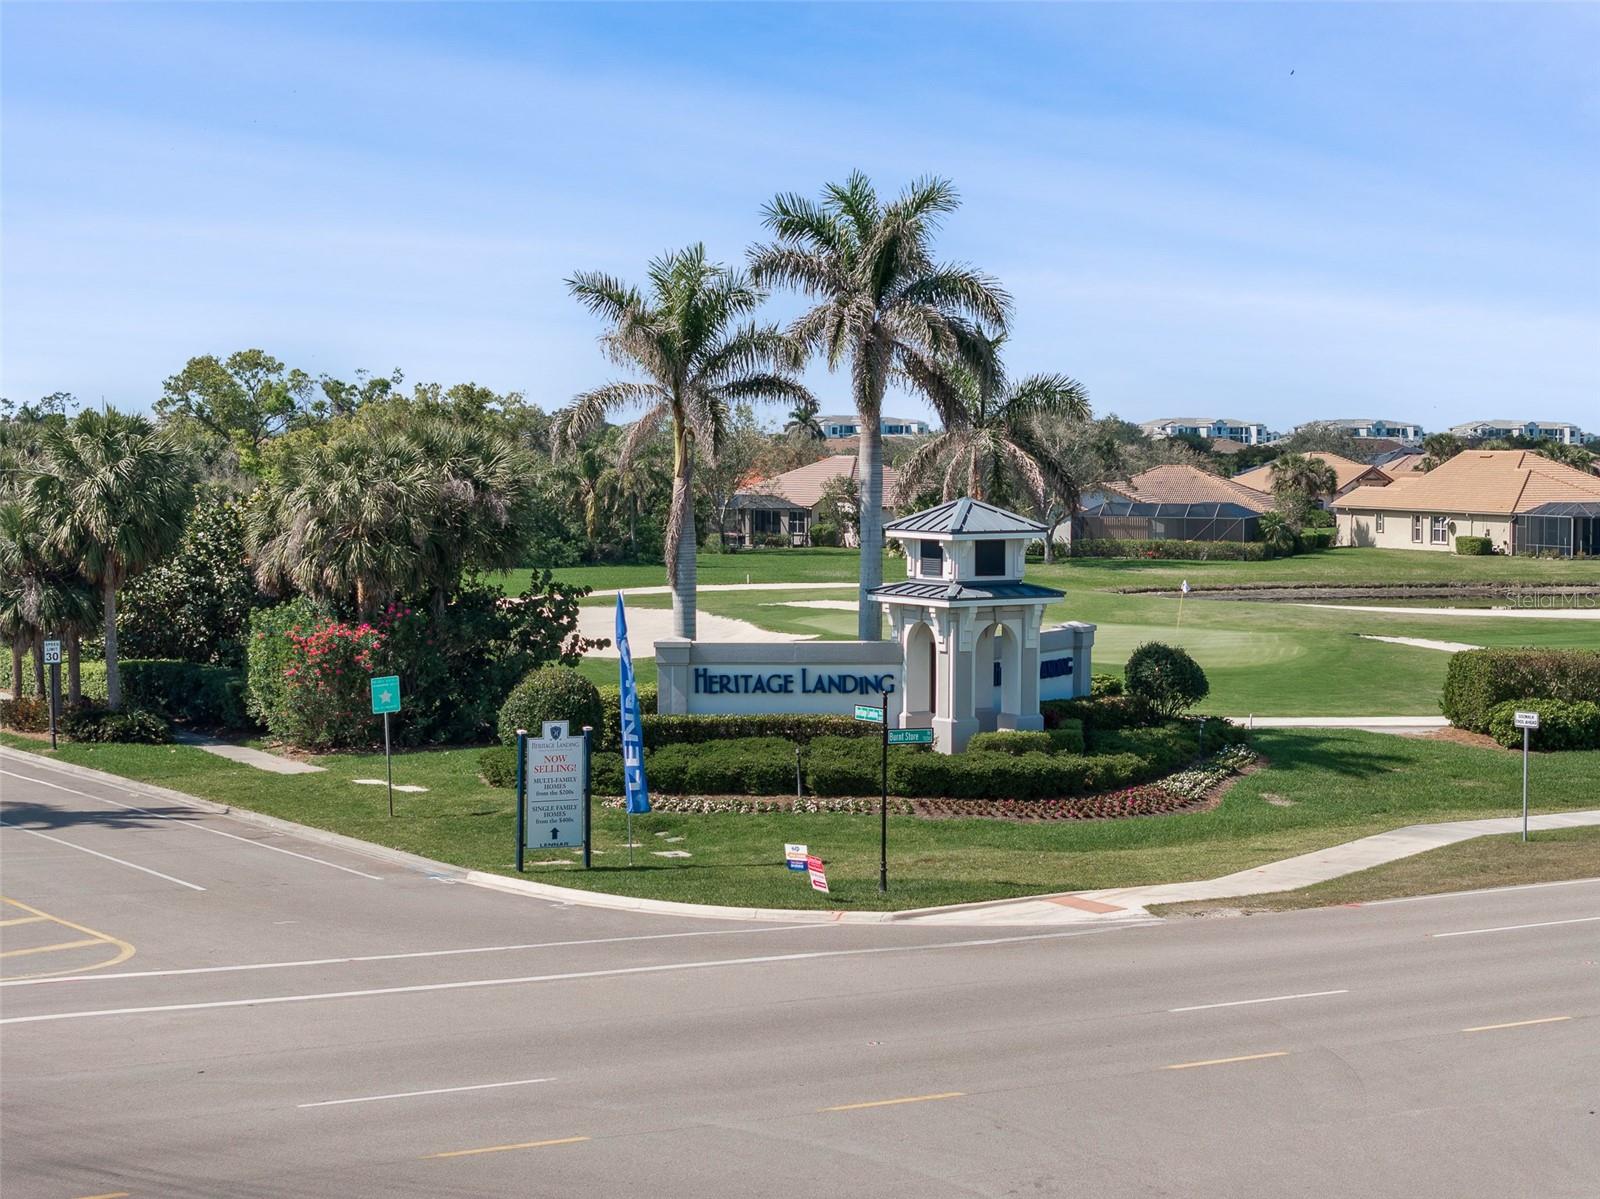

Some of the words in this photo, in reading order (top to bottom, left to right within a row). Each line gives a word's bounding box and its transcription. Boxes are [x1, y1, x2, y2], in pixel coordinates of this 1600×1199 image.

[46, 652, 59, 661] 30
[693, 667, 794, 694] HERITAGE
[801, 667, 895, 695] LANDING
[889, 732, 904, 742] Burnt
[904, 731, 919, 741] Store
[544, 754, 567, 763] NOW
[533, 764, 577, 774] SELLING!
